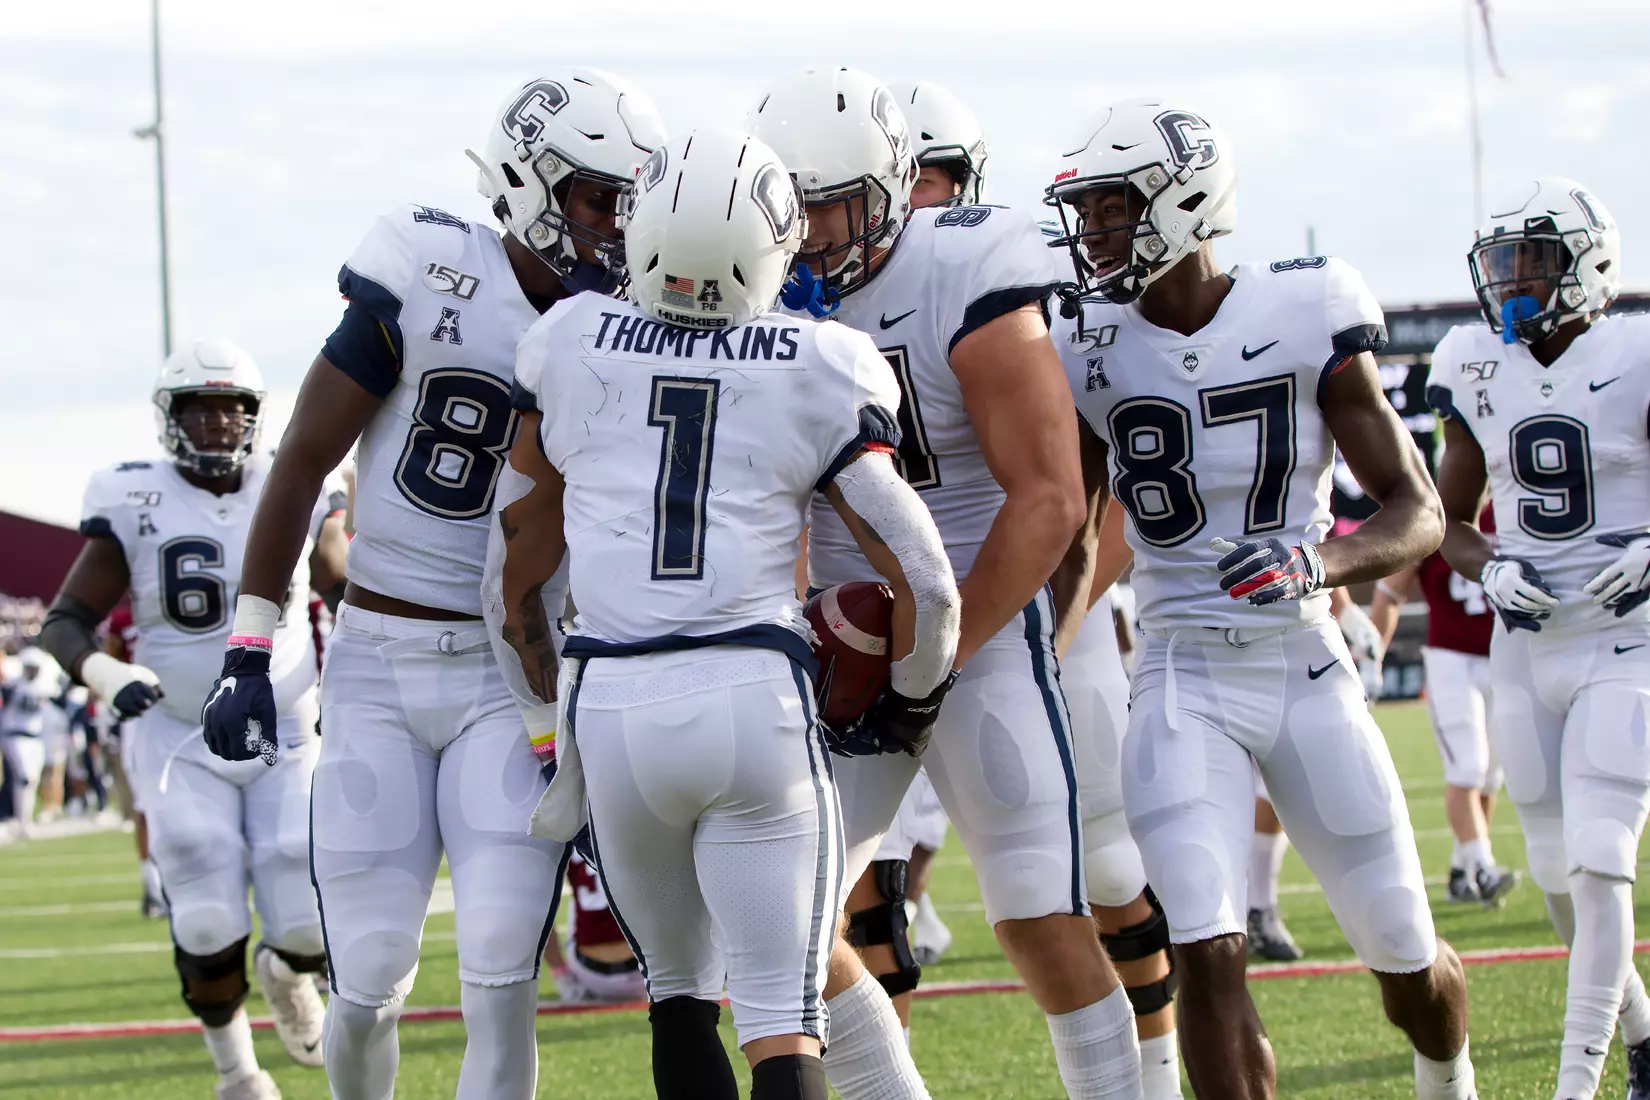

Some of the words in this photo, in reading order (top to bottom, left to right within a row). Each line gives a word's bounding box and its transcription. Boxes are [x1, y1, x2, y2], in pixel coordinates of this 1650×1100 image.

[1153, 110, 1220, 170] C
[421, 262, 482, 302] 150
[430, 307, 463, 345] A
[658, 308, 728, 328] HUSKIES
[701, 302, 718, 311] P6
[594, 312, 801, 361] THOMPKINS
[1085, 356, 1111, 393] A
[1460, 361, 1499, 384] 150
[392, 366, 518, 521] 8
[1106, 372, 1298, 549] 87
[647, 375, 721, 581] 1
[1508, 413, 1597, 541] 9
